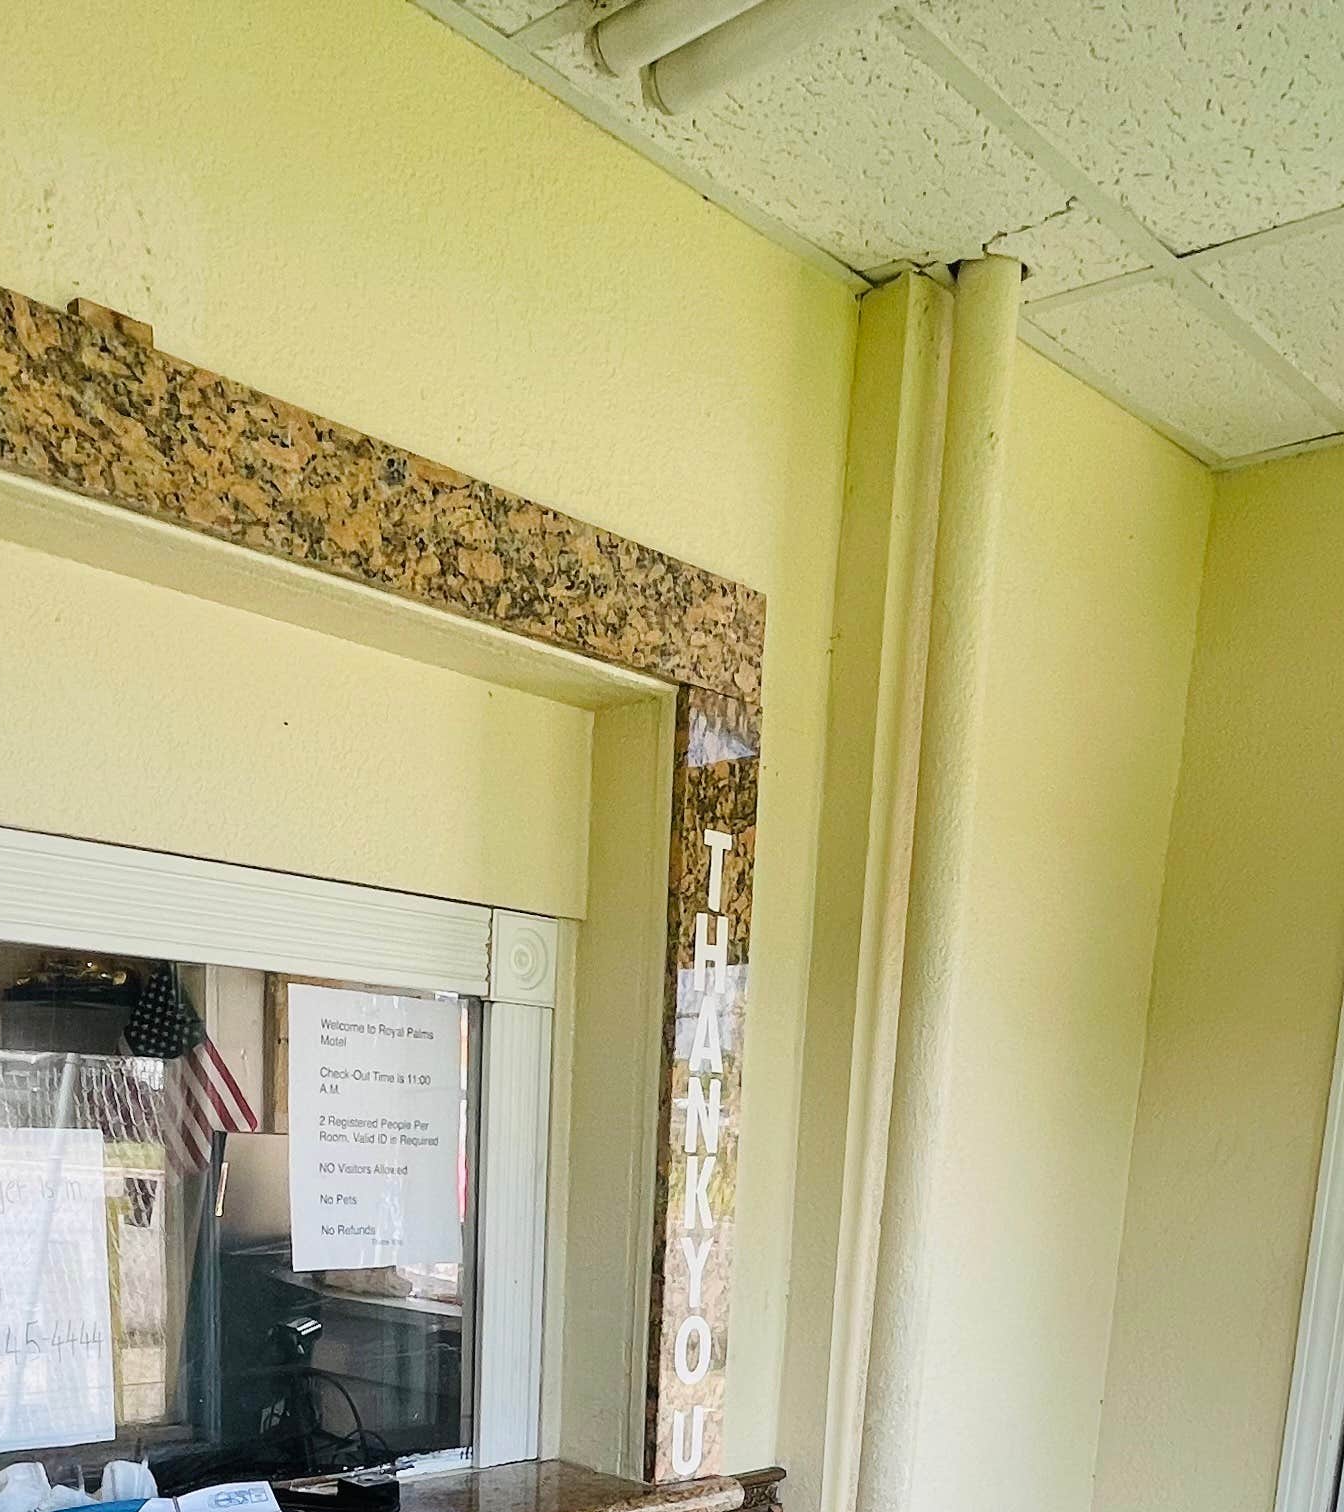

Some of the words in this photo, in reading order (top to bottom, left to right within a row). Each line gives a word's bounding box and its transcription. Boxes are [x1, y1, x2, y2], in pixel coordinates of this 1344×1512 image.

[320, 1018, 364, 1033] Welcome
[367, 1024, 377, 1034] to
[379, 1024, 404, 1038] Royal
[407, 1027, 434, 1040] Palms
[320, 1034, 347, 1047] Motel
[373, 1071, 395, 1083] Time
[397, 1073, 405, 1083] is
[408, 1074, 431, 1085] 11:00
[319, 1115, 325, 1126] 2
[328, 1116, 378, 1129] Registered
[381, 1118, 411, 1130] People
[414, 1120, 429, 1131] Per
[353, 1132, 375, 1143] Valid
[377, 1133, 388, 1144] ID
[400, 1134, 439, 1147] Required
[319, 1162, 335, 1174] NO
[338, 1163, 371, 1174] Visitors
[374, 1164, 408, 1175] Allowed
[65, 1177, 83, 1201] in
[320, 1194, 334, 1205] No
[336, 1194, 358, 1205] Pets
[321, 1225, 335, 1236] No
[338, 1225, 376, 1236] Refunds
